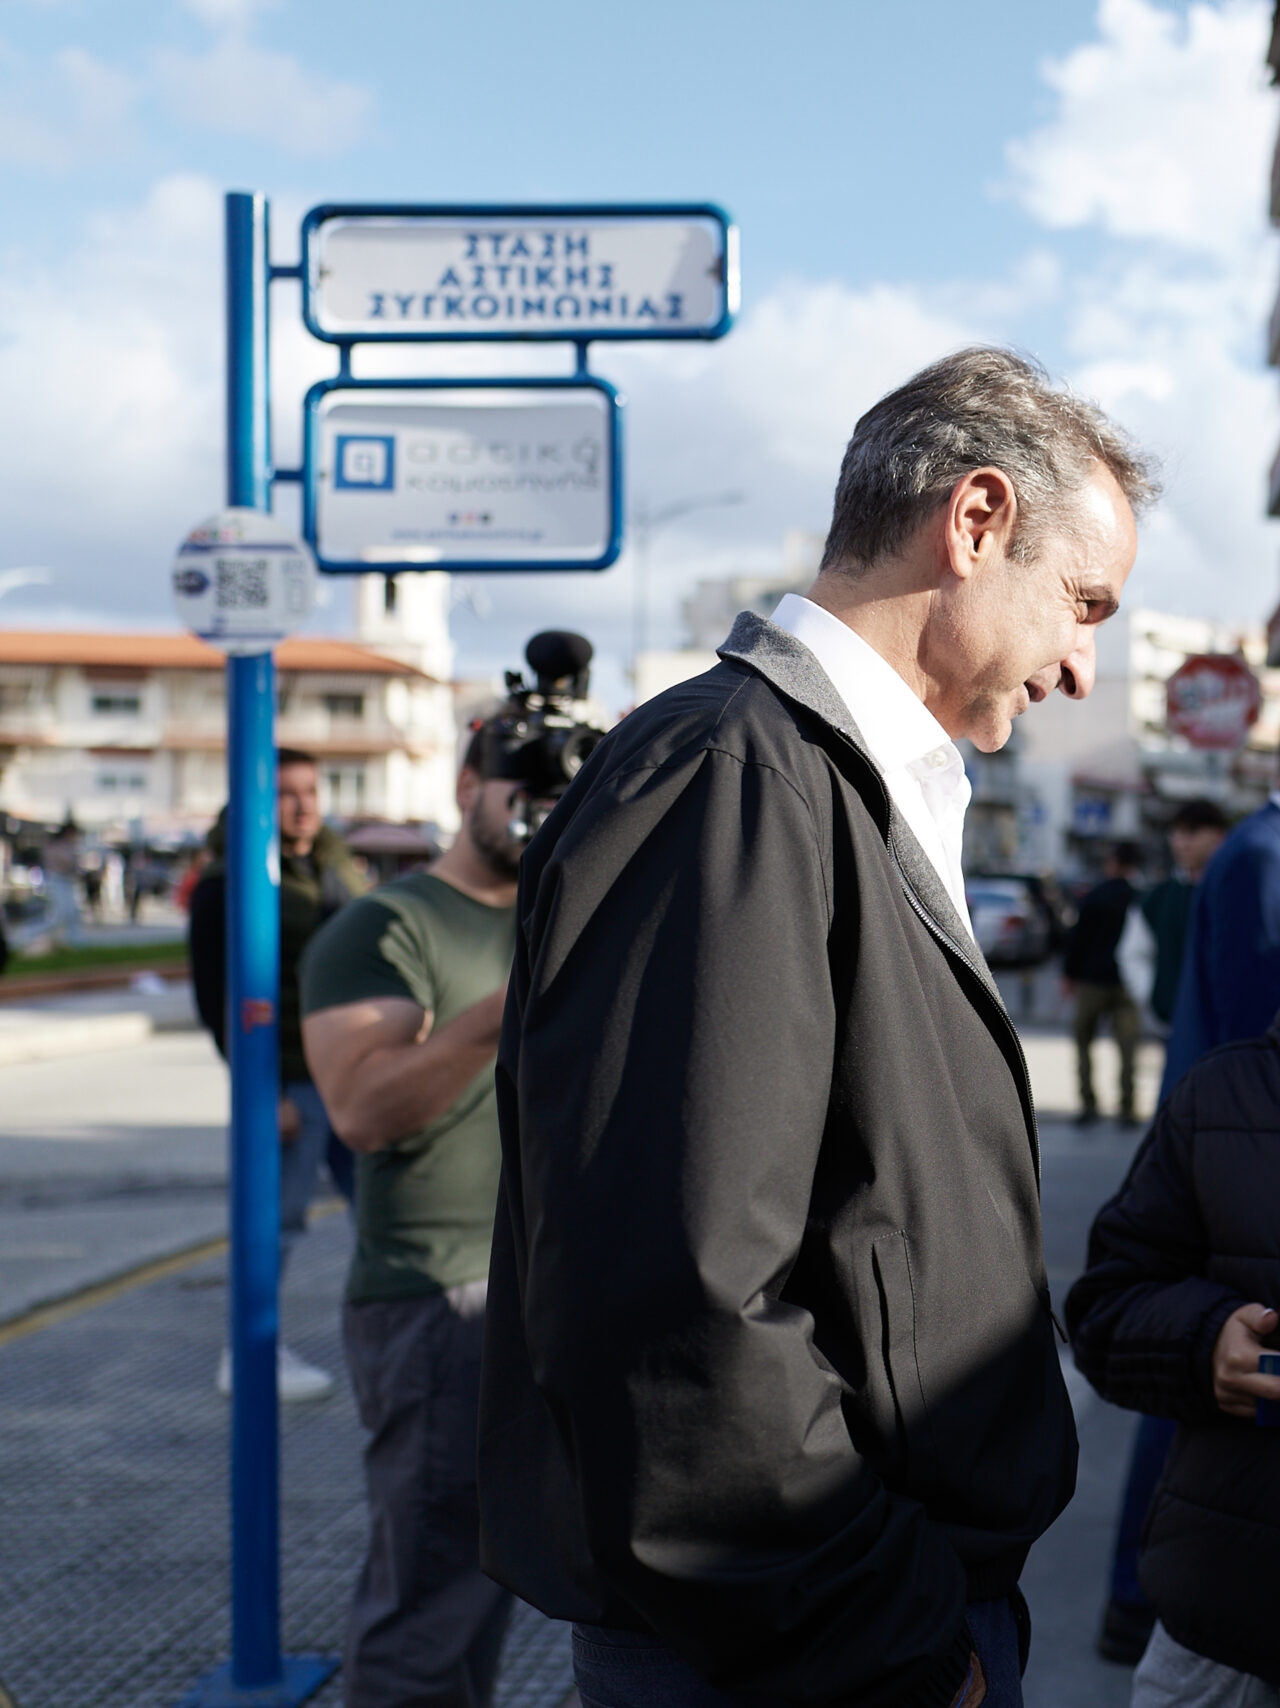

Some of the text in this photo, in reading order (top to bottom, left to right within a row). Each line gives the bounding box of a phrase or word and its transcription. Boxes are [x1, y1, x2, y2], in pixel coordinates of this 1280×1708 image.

[464, 232, 589, 259] ΣΤΑΣΗ
[438, 263, 614, 289] ΑΣΤΙΚΗΣ
[368, 293, 685, 319] ΣΥΓΚΟΙΝΩΝΙΑΣ
